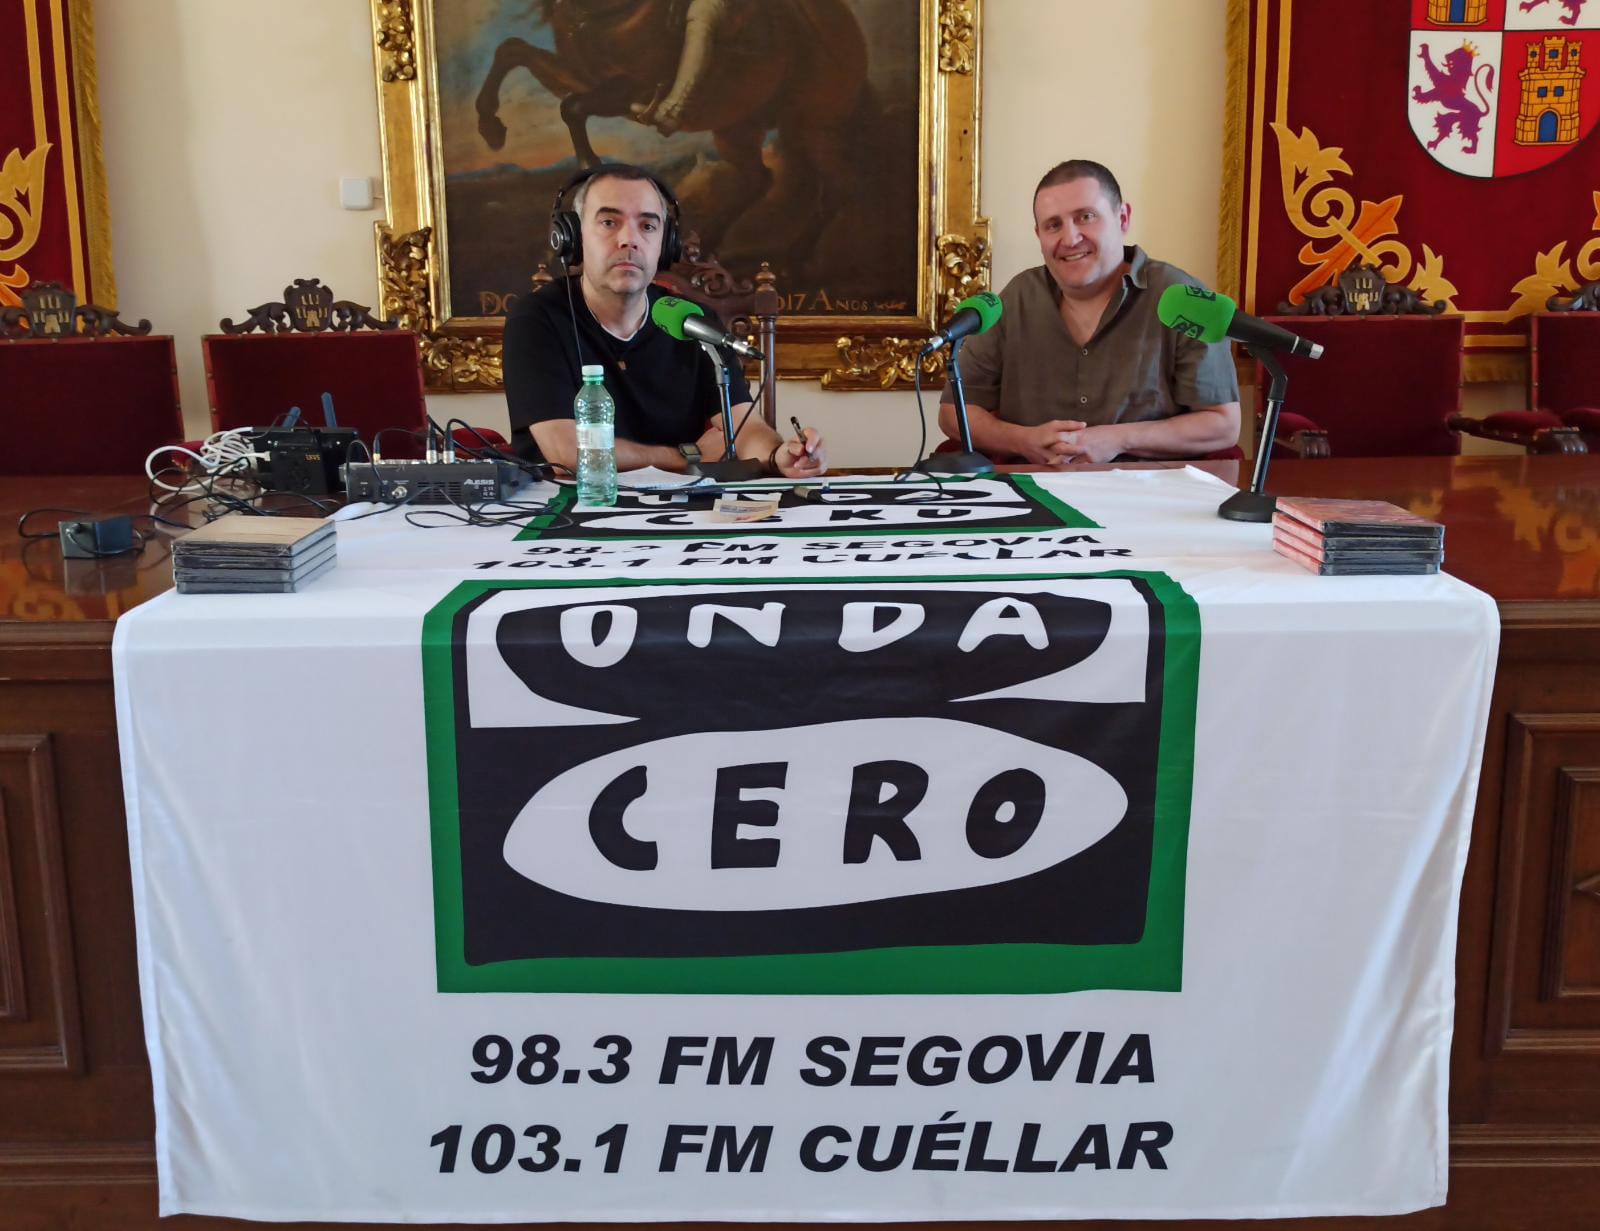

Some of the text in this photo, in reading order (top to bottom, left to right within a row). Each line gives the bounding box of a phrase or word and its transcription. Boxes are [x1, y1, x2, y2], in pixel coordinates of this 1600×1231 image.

[646, 509, 972, 525] CRO
[678, 556, 779, 566] FM
[683, 541, 779, 552] FM
[559, 596, 1050, 668] ONDA
[588, 759, 1047, 872] CERO
[470, 1031, 1156, 1087] 98.3 FM SEGOVIA
[429, 1110, 1174, 1174] 103.1 FM CUÉLLAR
